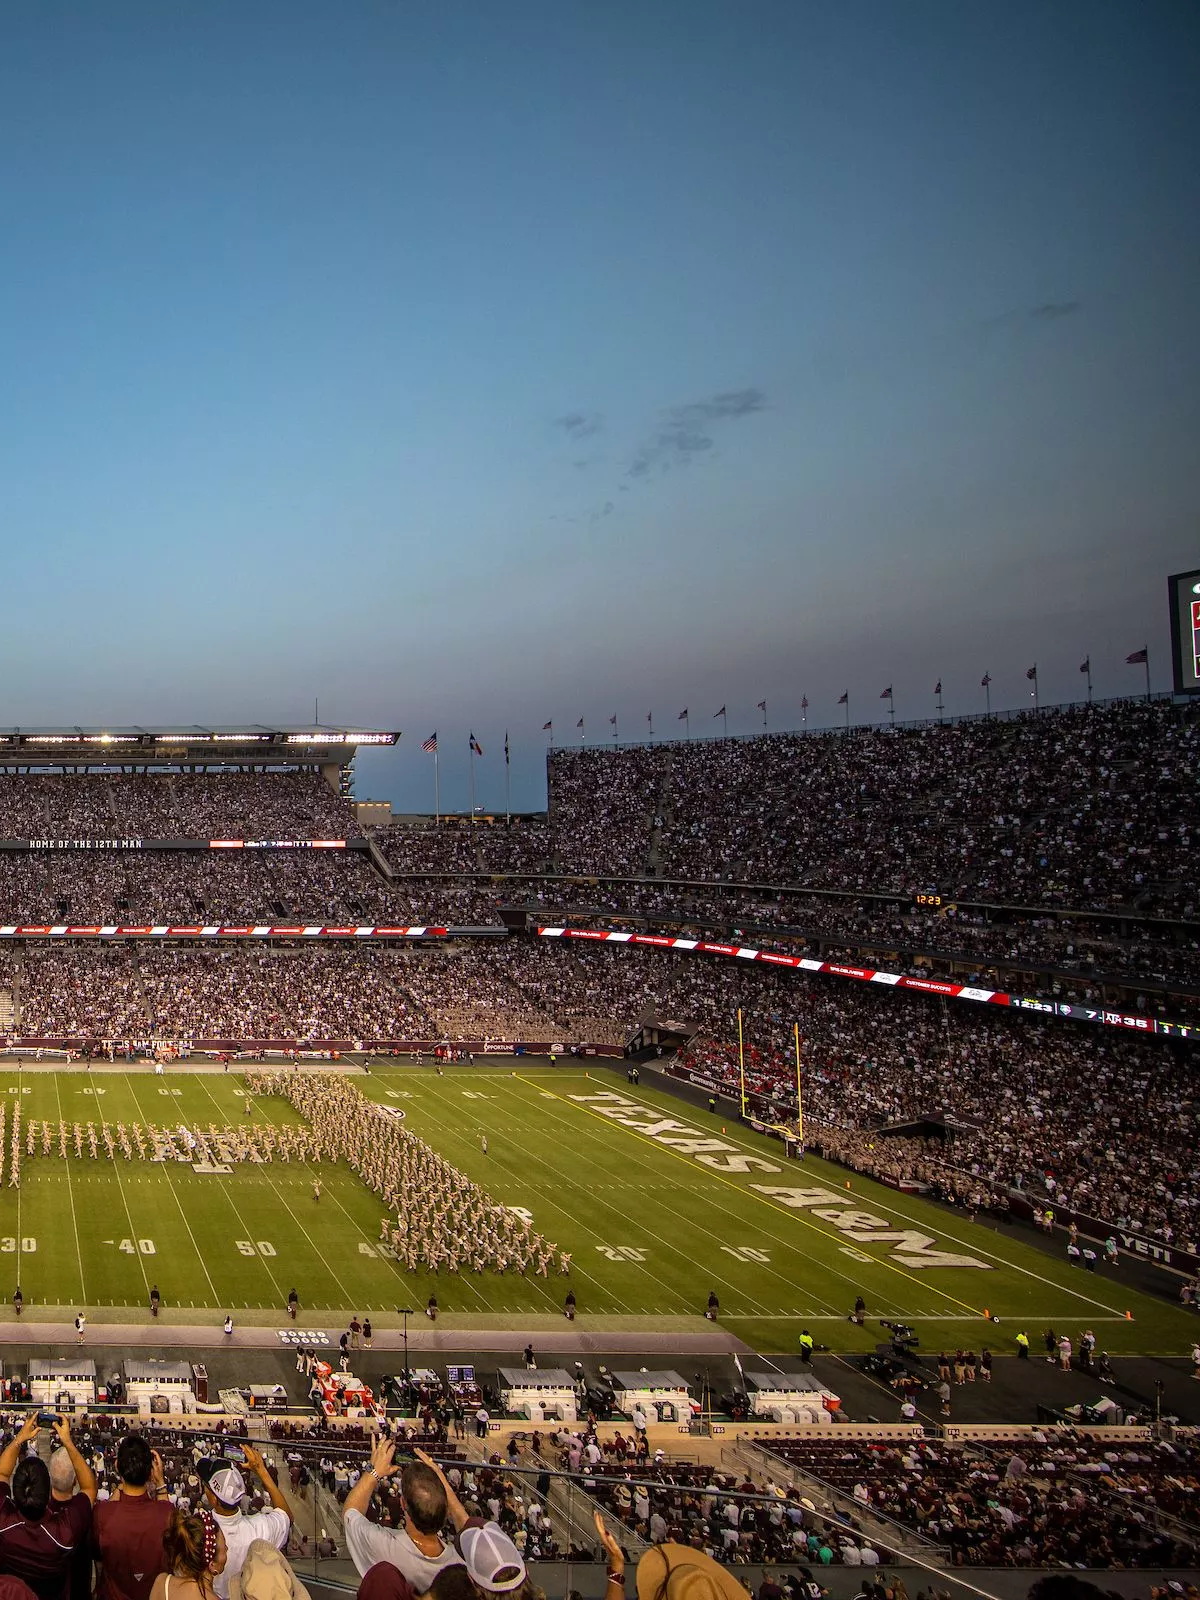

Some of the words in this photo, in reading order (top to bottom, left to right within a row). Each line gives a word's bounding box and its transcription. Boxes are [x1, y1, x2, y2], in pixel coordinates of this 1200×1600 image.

[29, 840, 55, 848] HOME
[58, 840, 70, 848] OF
[73, 840, 92, 848] THE
[95, 840, 118, 848] 12TH
[121, 840, 142, 848] MAN
[916, 895, 941, 905] 12:23
[1013, 999, 1053, 1012] 12:23
[1085, 1010, 1097, 1019] 7
[1123, 1017, 1148, 1029] 35
[689, 1072, 717, 1090] Community
[567, 1090, 784, 1174] TEXAS
[748, 1183, 996, 1270] A&M
[0, 1237, 37, 1253] 30
[118, 1239, 156, 1255] 40
[235, 1240, 277, 1257] 50
[358, 1242, 399, 1259] 40
[1120, 1233, 1171, 1264] YETI
[595, 1246, 645, 1262] 20
[721, 1246, 772, 1263] 10
[805, 1582, 822, 1599] 12
